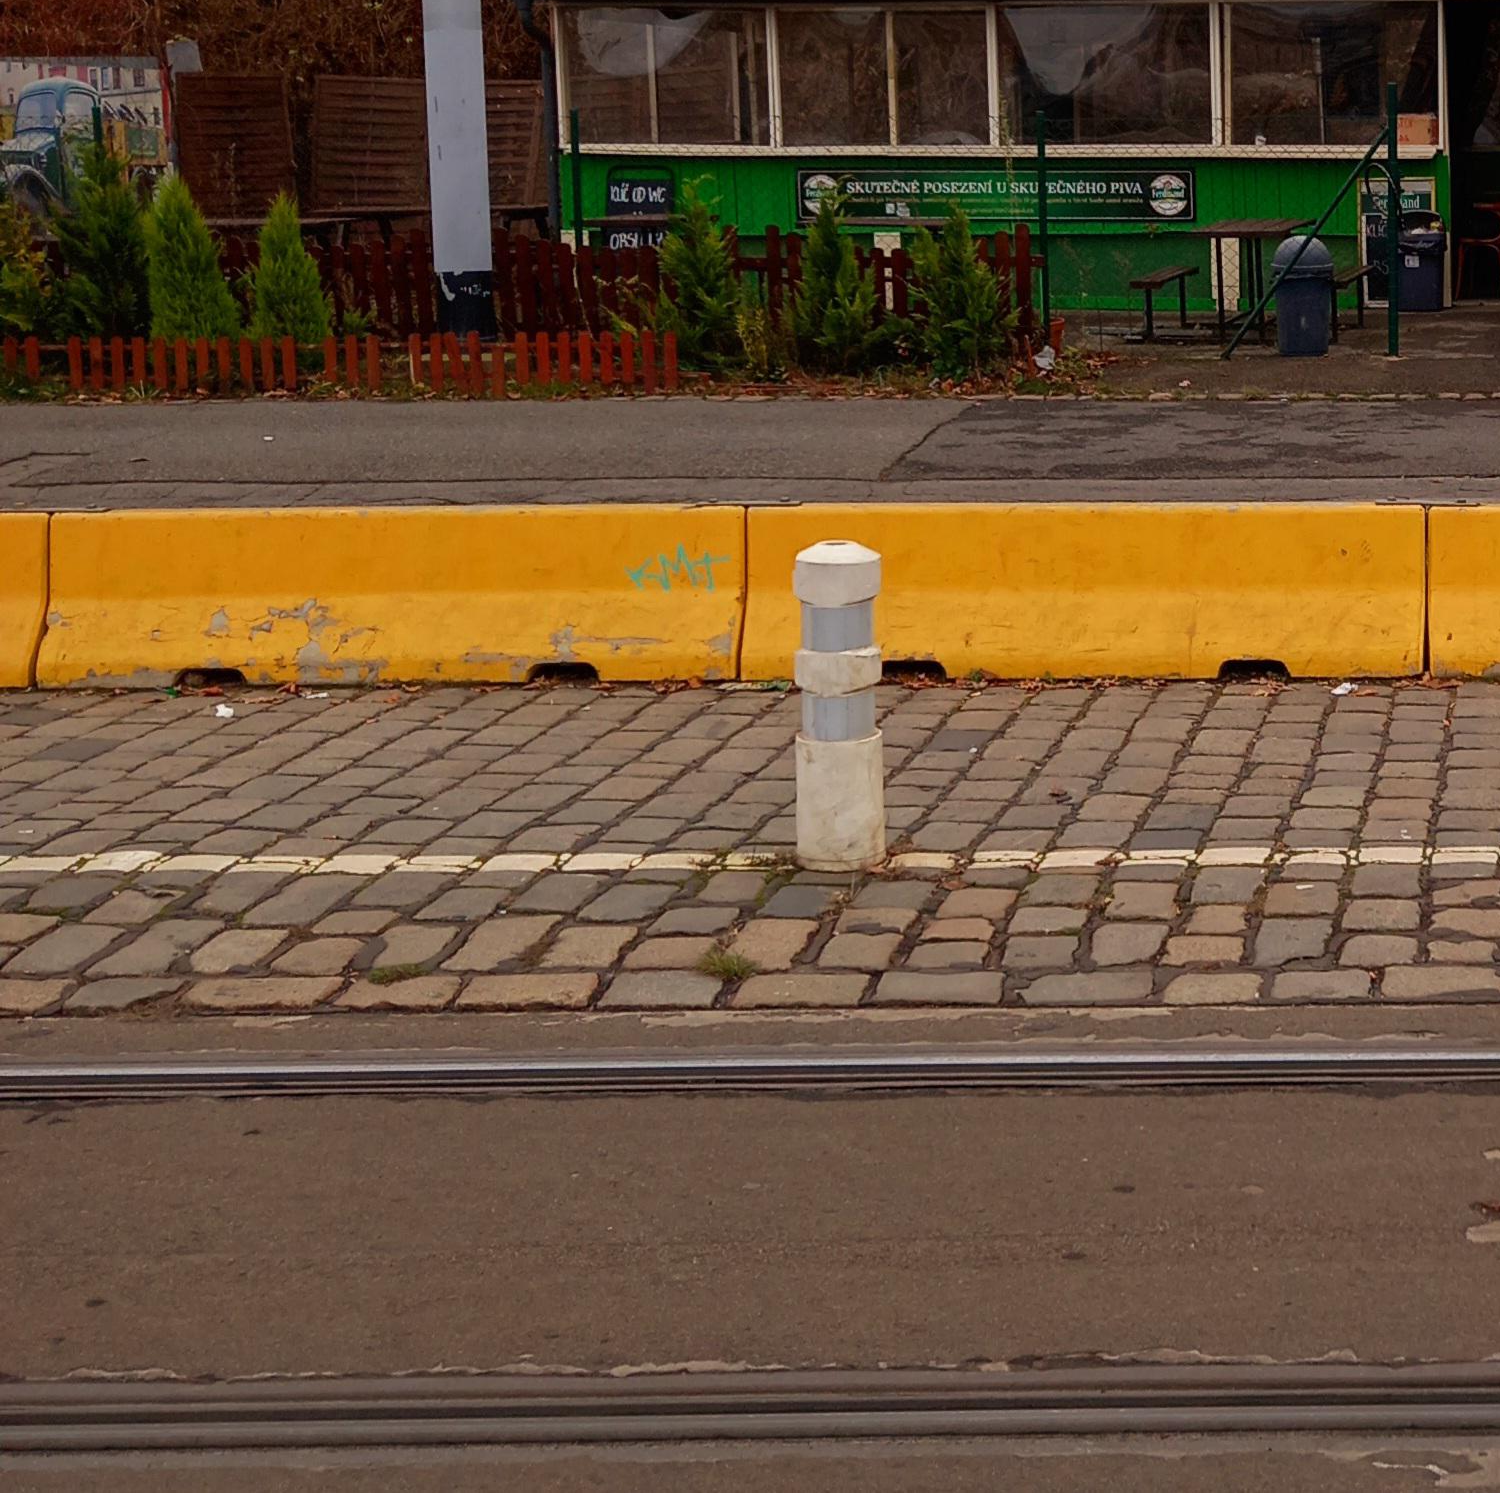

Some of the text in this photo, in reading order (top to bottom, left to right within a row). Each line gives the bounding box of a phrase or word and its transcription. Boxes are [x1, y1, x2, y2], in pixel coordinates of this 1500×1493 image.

[846, 179, 1144, 194] SKUTEČNÉ POSEZENÍ U SKUEČNÉHO PIVA
